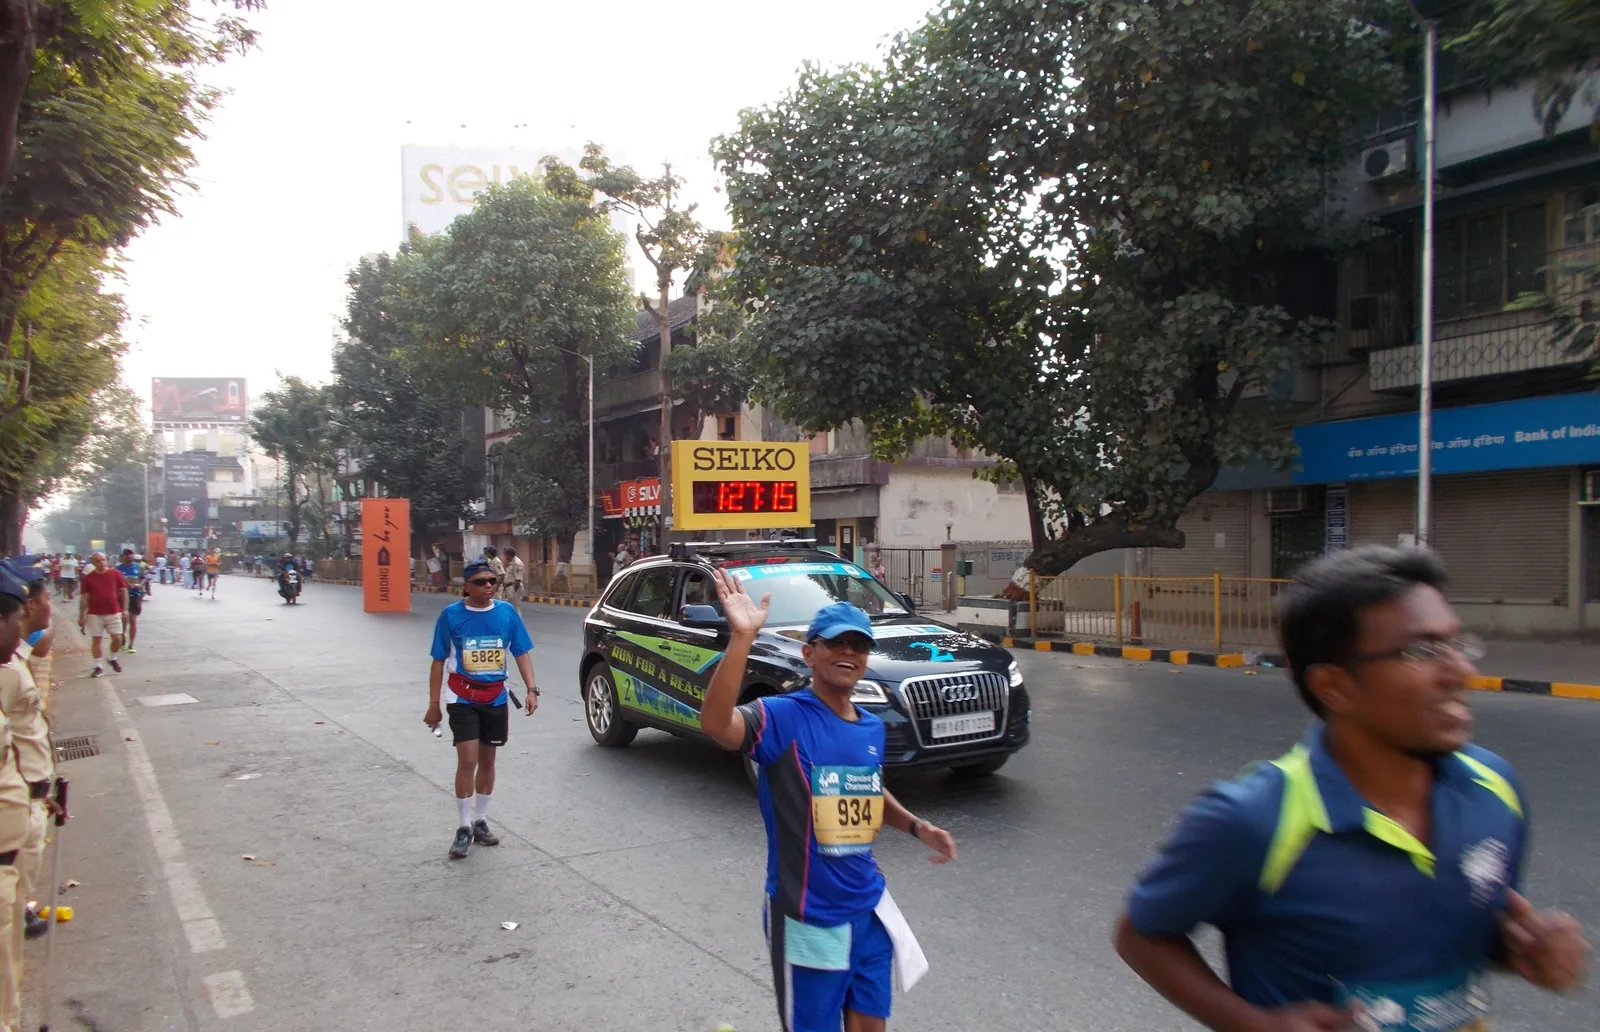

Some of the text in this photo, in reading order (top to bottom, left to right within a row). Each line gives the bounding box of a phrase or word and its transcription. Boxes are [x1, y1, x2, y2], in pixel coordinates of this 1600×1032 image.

[1515, 429, 1549, 443] Bank
[1551, 427, 1567, 439] of
[693, 447, 796, 471] SEIKO
[639, 484, 661, 502] SILV
[760, 565, 791, 575] LEAD
[379, 566, 390, 604] JABONG
[471, 650, 500, 663] 5822
[611, 645, 706, 701] RUN FOR A REAS
[837, 798, 872, 826] 934
